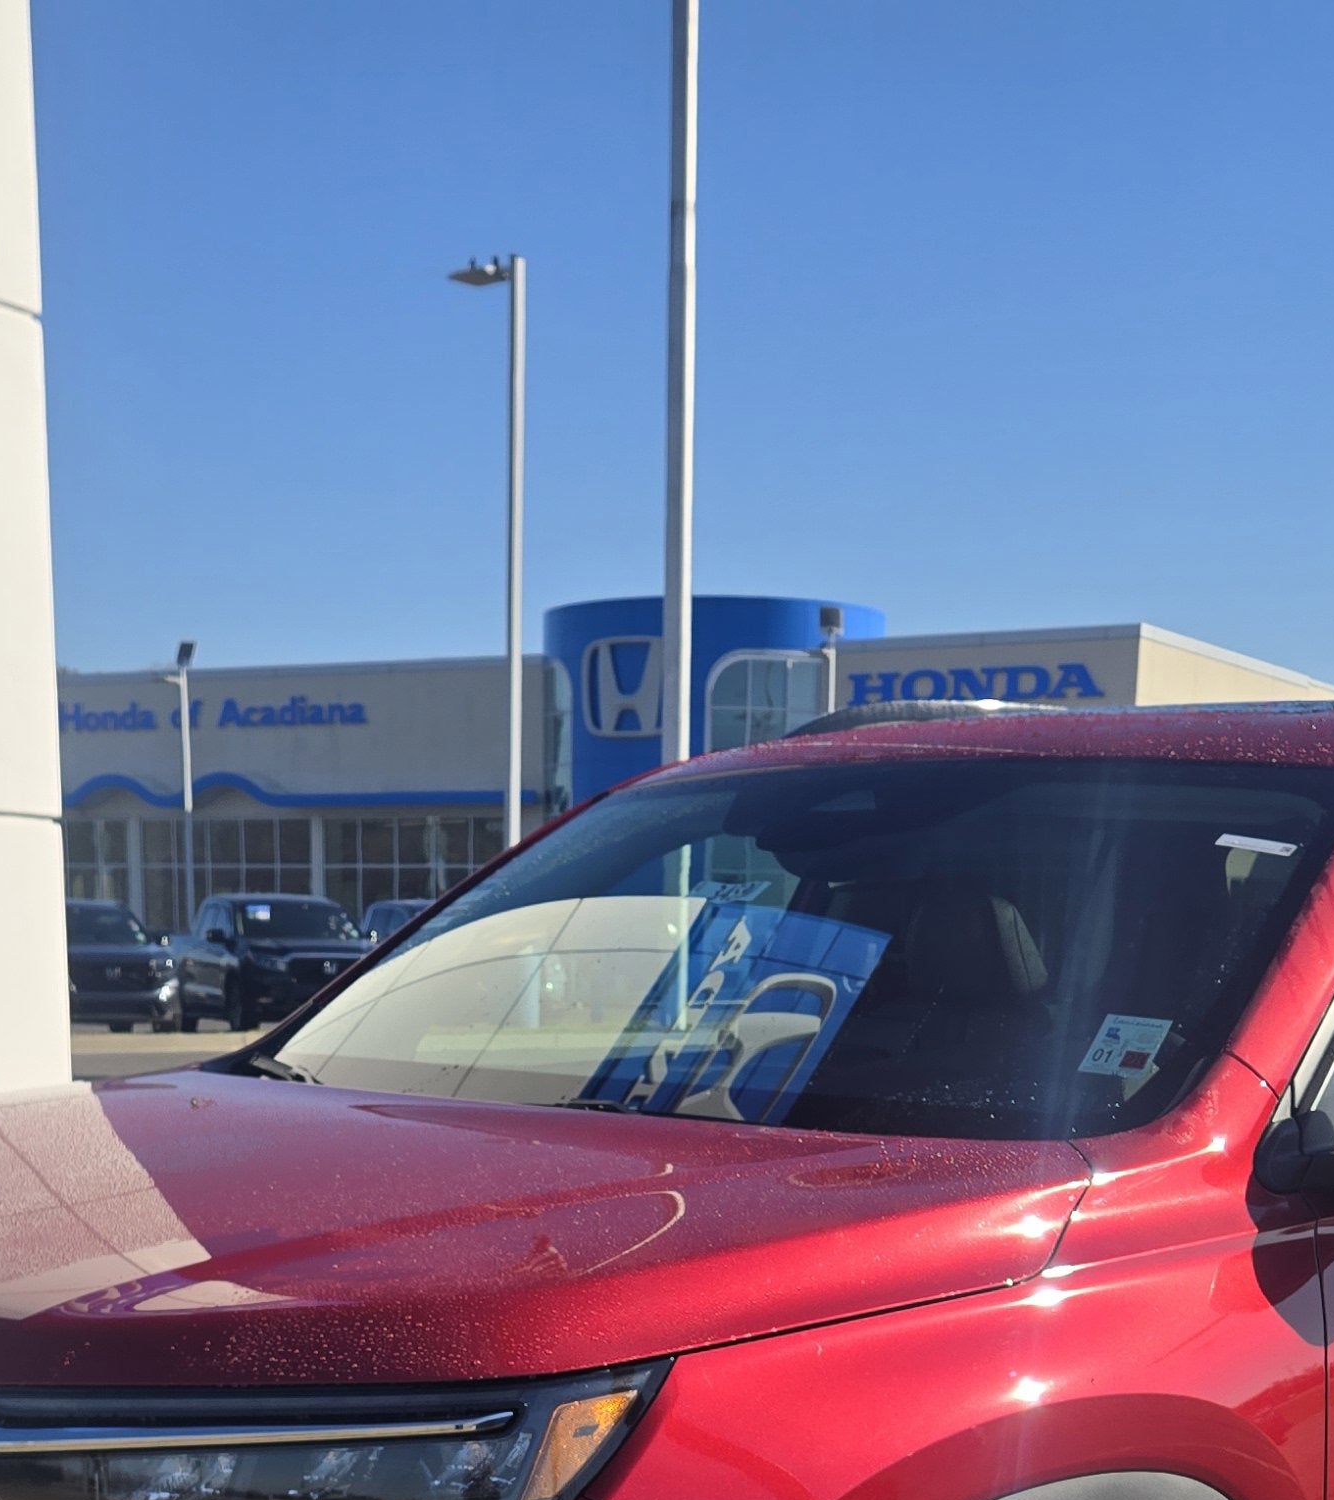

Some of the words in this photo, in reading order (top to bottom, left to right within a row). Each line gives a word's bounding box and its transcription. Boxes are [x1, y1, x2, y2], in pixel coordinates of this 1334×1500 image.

[847, 662, 1105, 707] HONDA
[58, 700, 156, 731] Honda
[170, 699, 202, 729] of
[218, 695, 366, 727] Acadiana
[1092, 1047, 1115, 1063] 01
